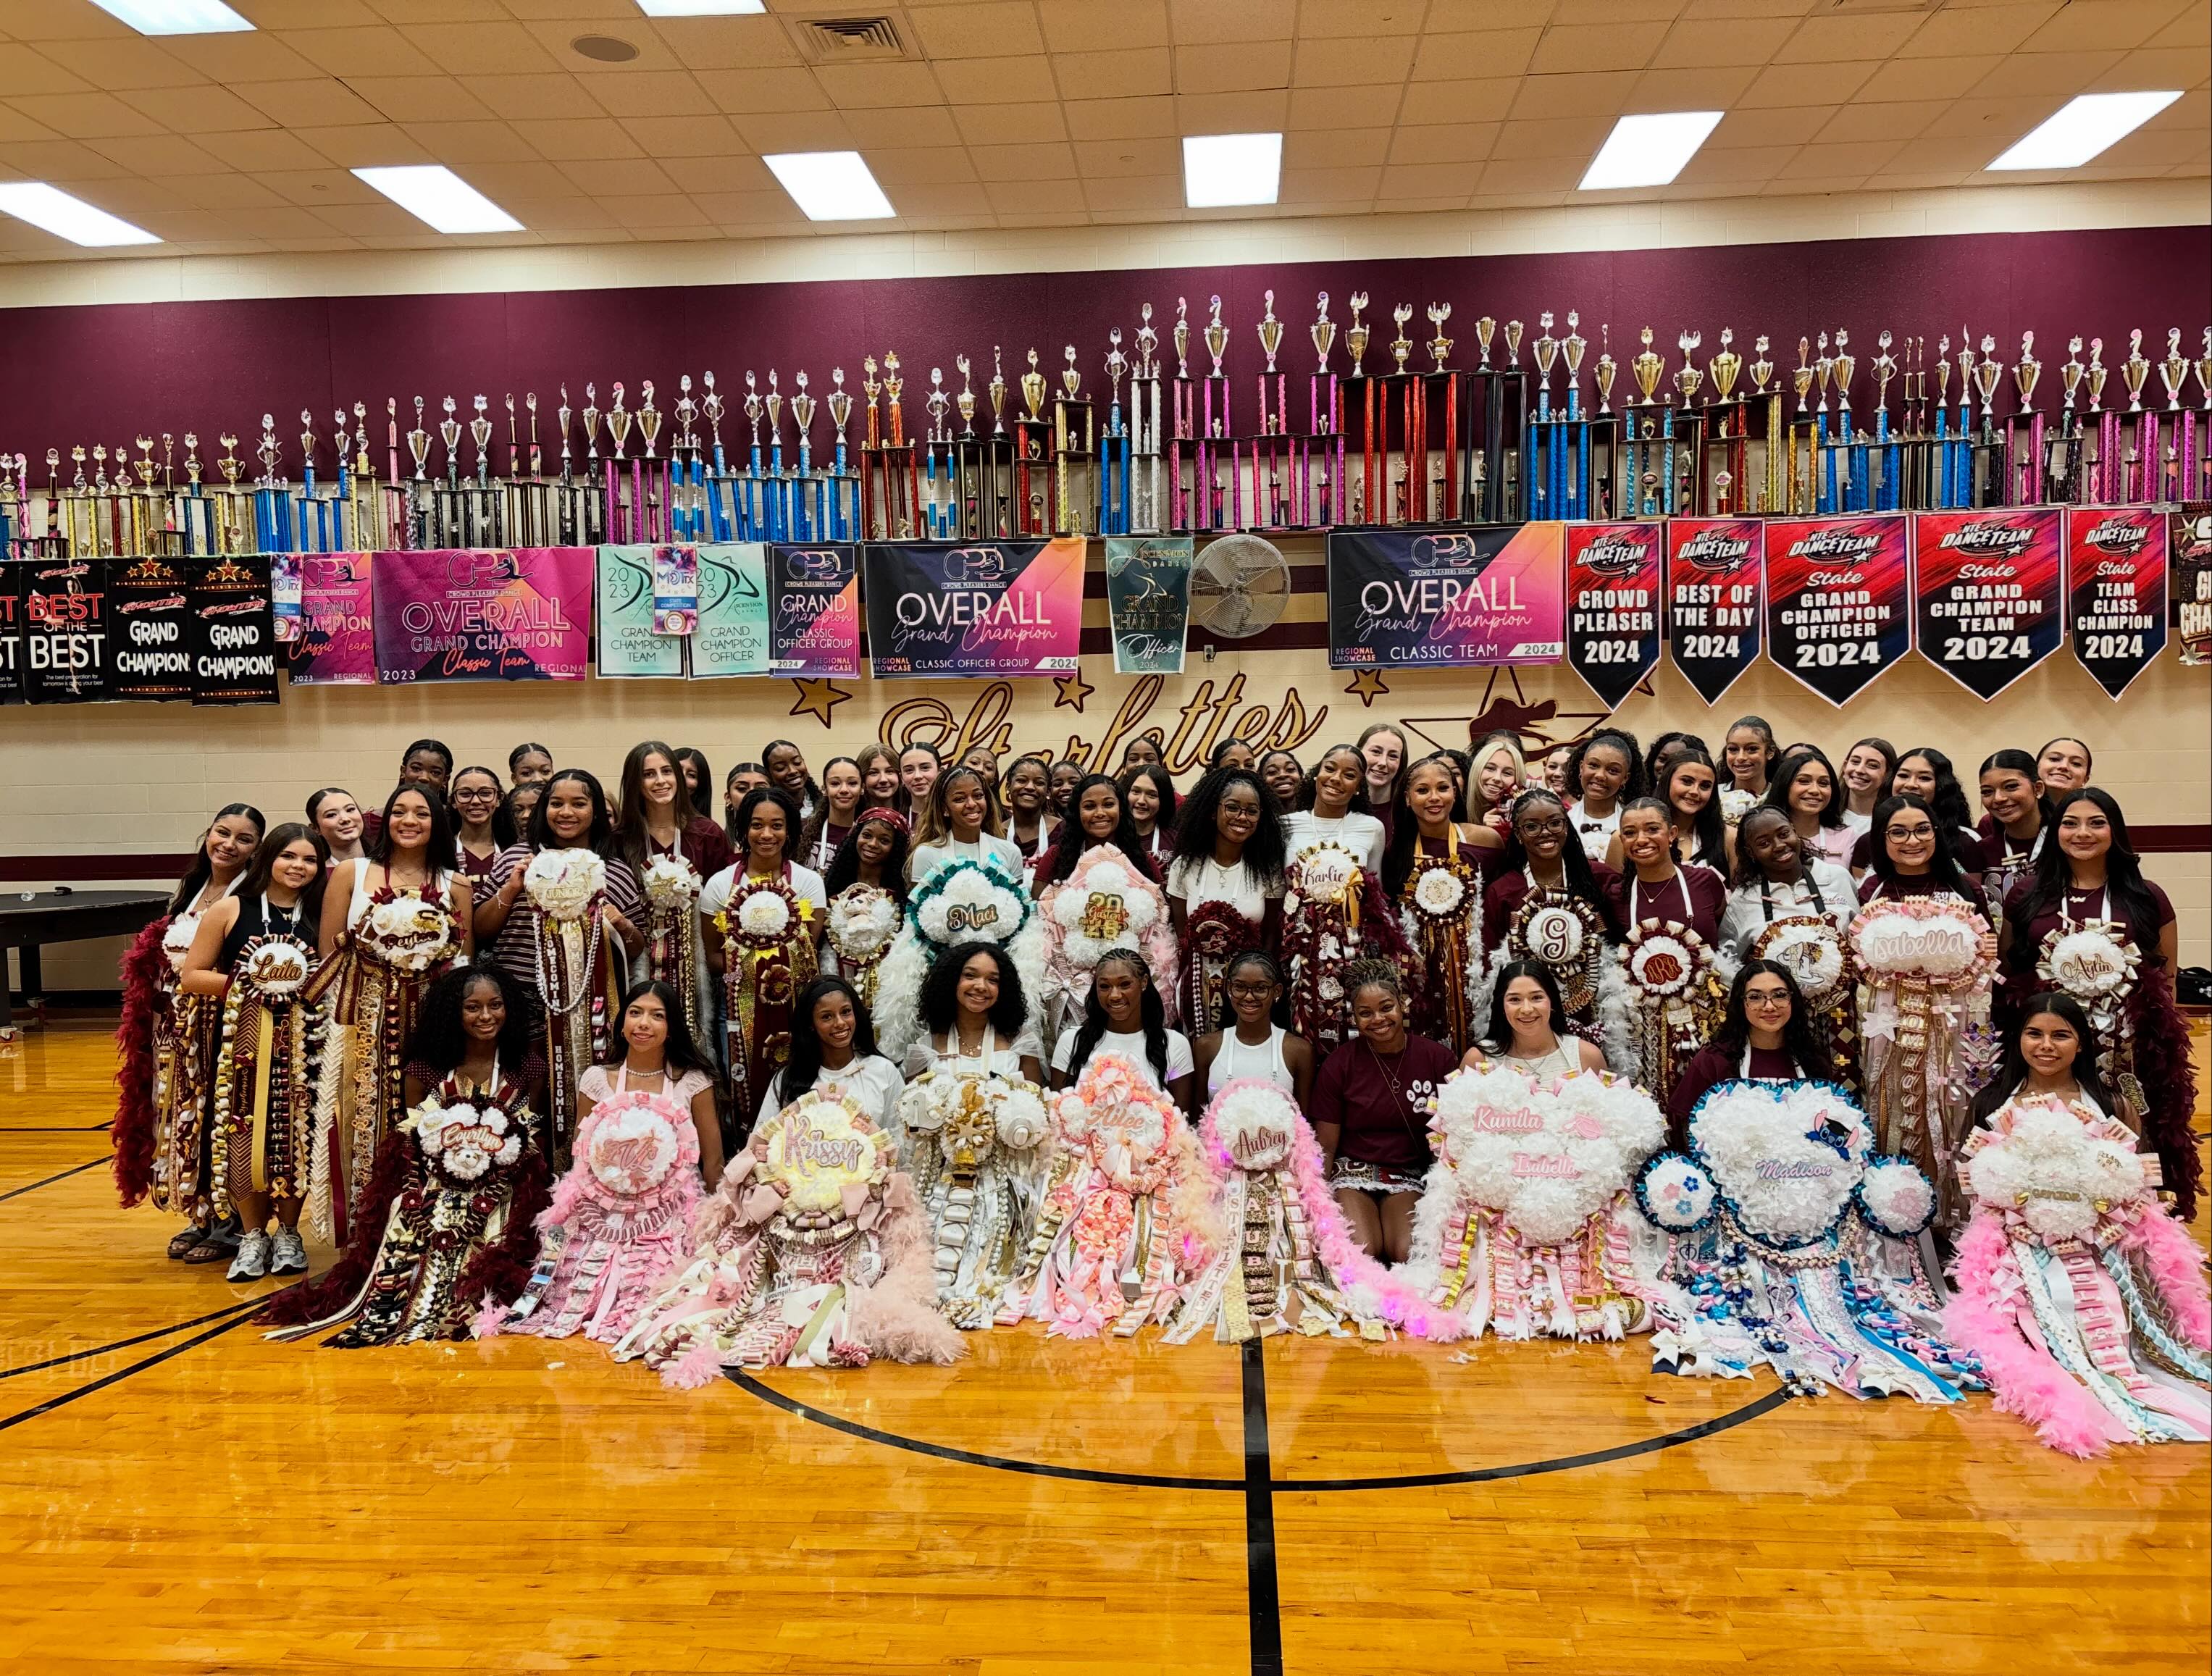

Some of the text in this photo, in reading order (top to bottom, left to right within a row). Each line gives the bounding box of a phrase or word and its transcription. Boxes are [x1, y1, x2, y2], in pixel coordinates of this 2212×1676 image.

[1940, 529, 2033, 548] DANCE TEAM
[2085, 527, 2148, 544] DANCE TEAM
[1576, 544, 1647, 564] DANCE TEAM
[1677, 540, 1750, 558] DANCE TEAM
[1788, 535, 1880, 556] DANCE TEAM
[608, 567, 629, 582] 20
[1957, 563, 2017, 579] State
[2096, 561, 2137, 576] State
[1806, 570, 1864, 587] State
[609, 584, 629, 598] 23
[1361, 577, 1525, 615] OVERALL
[1676, 584, 1753, 603] BEST OF
[1801, 590, 1871, 608] GRAND
[1951, 584, 2023, 600] GRAND
[2097, 582, 2135, 597] TEAM
[29, 593, 104, 621] BEST
[303, 600, 356, 615] GRAND
[781, 595, 847, 613] GRAND
[896, 591, 1051, 627] OVERALL
[1120, 595, 1178, 613] GRAND
[1579, 590, 1648, 609] CROWD
[1930, 600, 2043, 617] CHAMPION
[2093, 599, 2137, 614] CLASS
[301, 616, 371, 632] HAMPION
[402, 597, 571, 634] OVERALL
[776, 601, 852, 633] Champion
[1355, 601, 1532, 642] Grand Champion
[1574, 612, 1653, 632] PLEASER
[1675, 608, 1754, 627] THE DAY
[1781, 606, 1890, 625] CHAMPION
[1958, 617, 2014, 632] TEAM
[2077, 615, 2153, 631] CHAMPION
[43, 621, 87, 632] OF THE
[130, 621, 178, 646] GRAND
[621, 627, 660, 637] GRAN
[711, 627, 750, 637] GRAND
[795, 629, 834, 638] CLASSIC
[891, 613, 1057, 653] Grand Champion
[1796, 623, 1877, 640] OFFICER
[210, 625, 259, 650] GRAND
[289, 631, 372, 661] Classic Team
[411, 632, 563, 652] GRAND CHAMPION
[611, 640, 671, 650] CHAMPION
[701, 638, 761, 650] CHAMPION
[778, 638, 852, 648] OFFICER GROUP
[1118, 634, 1181, 658] Officer
[1683, 635, 1740, 658] 2024
[2085, 634, 2144, 659] 2024
[30, 634, 105, 669] BEST
[628, 653, 656, 662] TEAM
[710, 651, 754, 662] OFFICER
[1391, 644, 1498, 660] CLASSIC TEAM
[1524, 644, 1556, 655] 2024
[1585, 640, 1640, 663] 2024
[1796, 641, 1881, 668] 2024
[1944, 636, 2032, 661] 2024
[117, 651, 190, 676] CHAMPION
[198, 655, 274, 679] CHAMPIONS
[443, 647, 530, 676] Classic Team
[916, 658, 1029, 669] CLASSIC OFFICER GROUP
[1050, 658, 1077, 668] 2024
[383, 670, 416, 681] 2023
[1304, 866, 1344, 885] Karlie
[548, 889, 582, 900] JUNIOR
[947, 905, 997, 931] Maci
[251, 953, 302, 983] Laila
[2061, 954, 2113, 981] Aylin
[555, 1045, 564, 1131] HOMECOMING
[1475, 1105, 1543, 1131] Kamila
[784, 1115, 863, 1178] Krissy
[1233, 1126, 1289, 1160] Aubrey
[1513, 1154, 1580, 1178] Isabella
[1756, 1160, 1832, 1179] Madison
